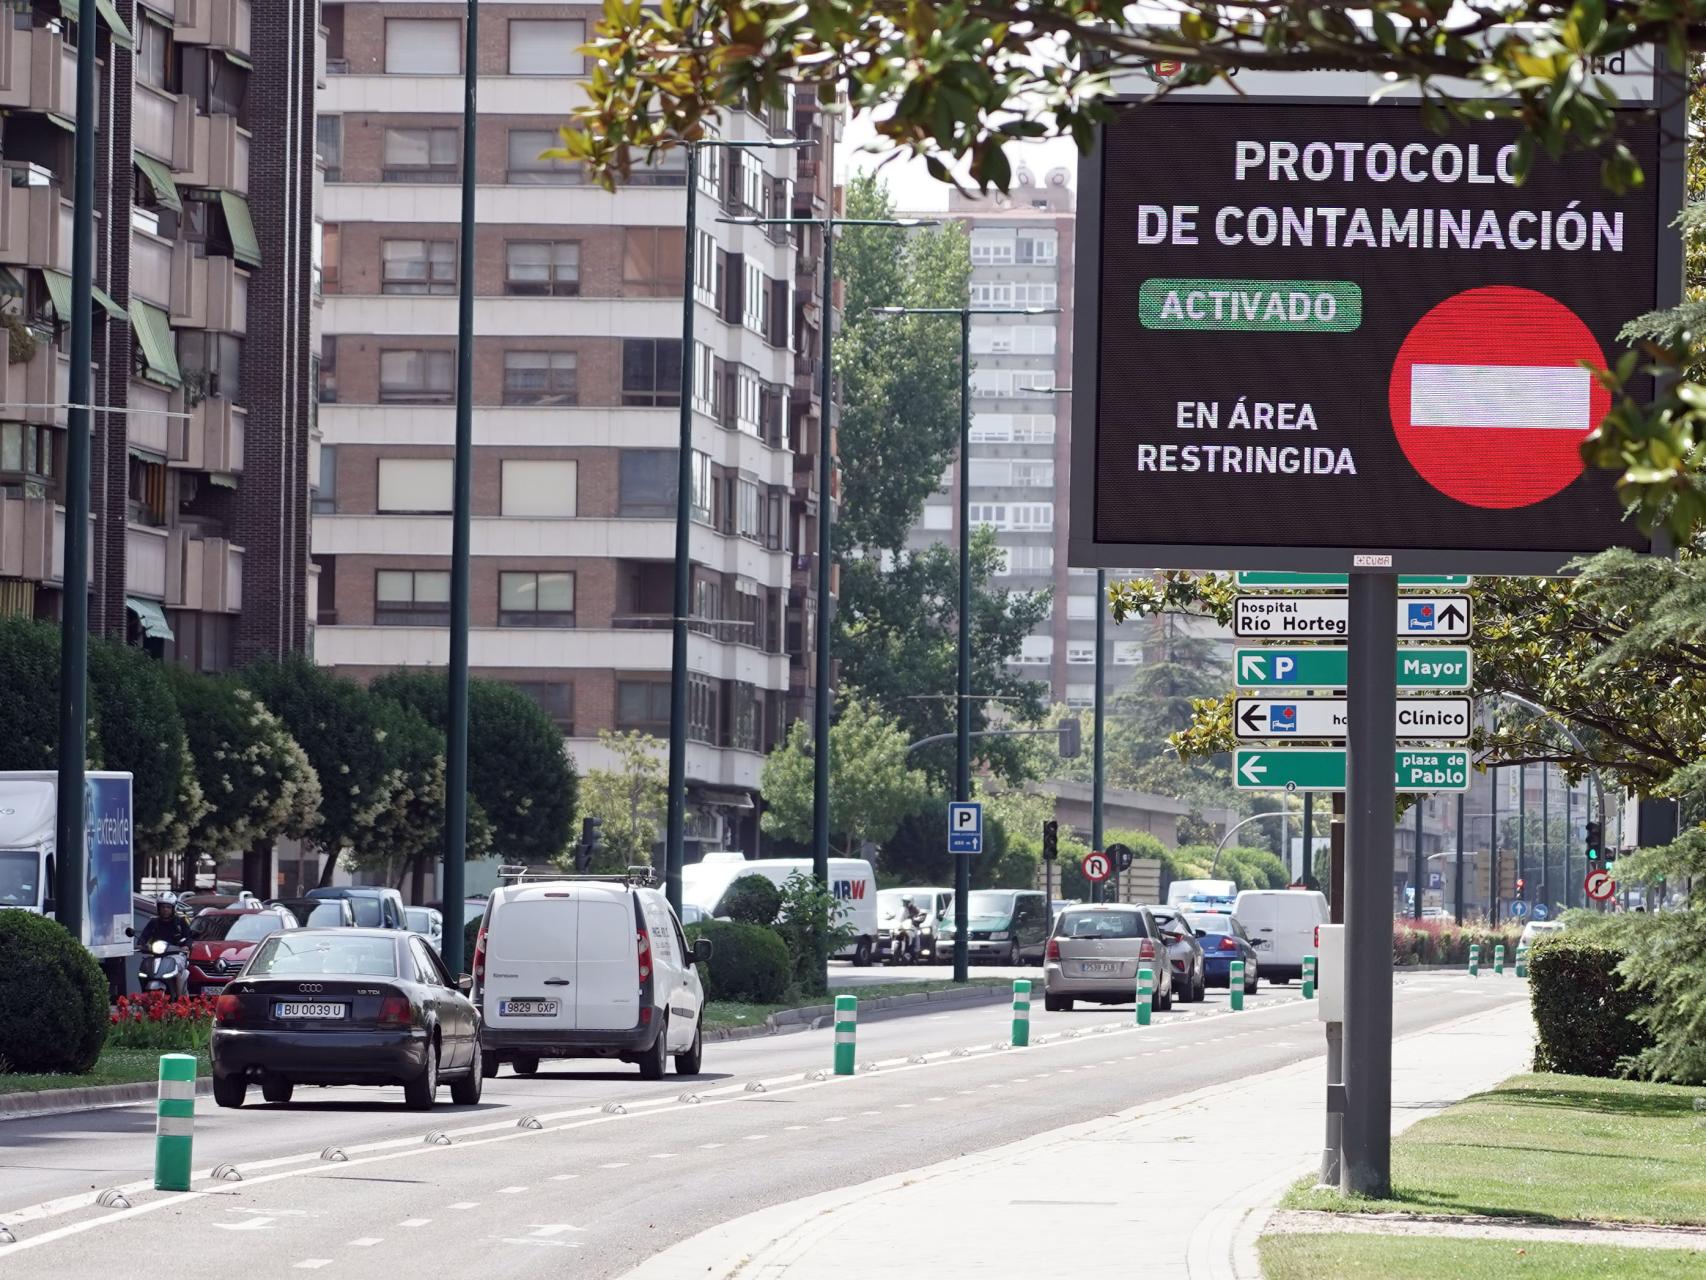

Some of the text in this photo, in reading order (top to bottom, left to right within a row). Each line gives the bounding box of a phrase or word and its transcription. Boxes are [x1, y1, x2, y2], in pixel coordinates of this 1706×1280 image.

[1235, 141, 1518, 184] PROTOCOLO
[1138, 201, 1624, 251] DE CONTAMINACIÓN
[1161, 290, 1337, 323] ACTIVADO
[1177, 396, 1318, 431] EN ÁREA
[1138, 445, 1357, 475] RESTRINGIDA
[1242, 603, 1298, 615] hospital
[1242, 616, 1346, 634] Río Horteg
[1276, 657, 1463, 680] P Mayor
[1398, 710, 1464, 725] Clínico
[1402, 754, 1464, 768] plaza de
[1411, 768, 1464, 784] Pablo
[959, 811, 972, 827] P
[284, 1004, 341, 1016] BU 0039 U
[507, 1002, 556, 1013] 9829 GXP
